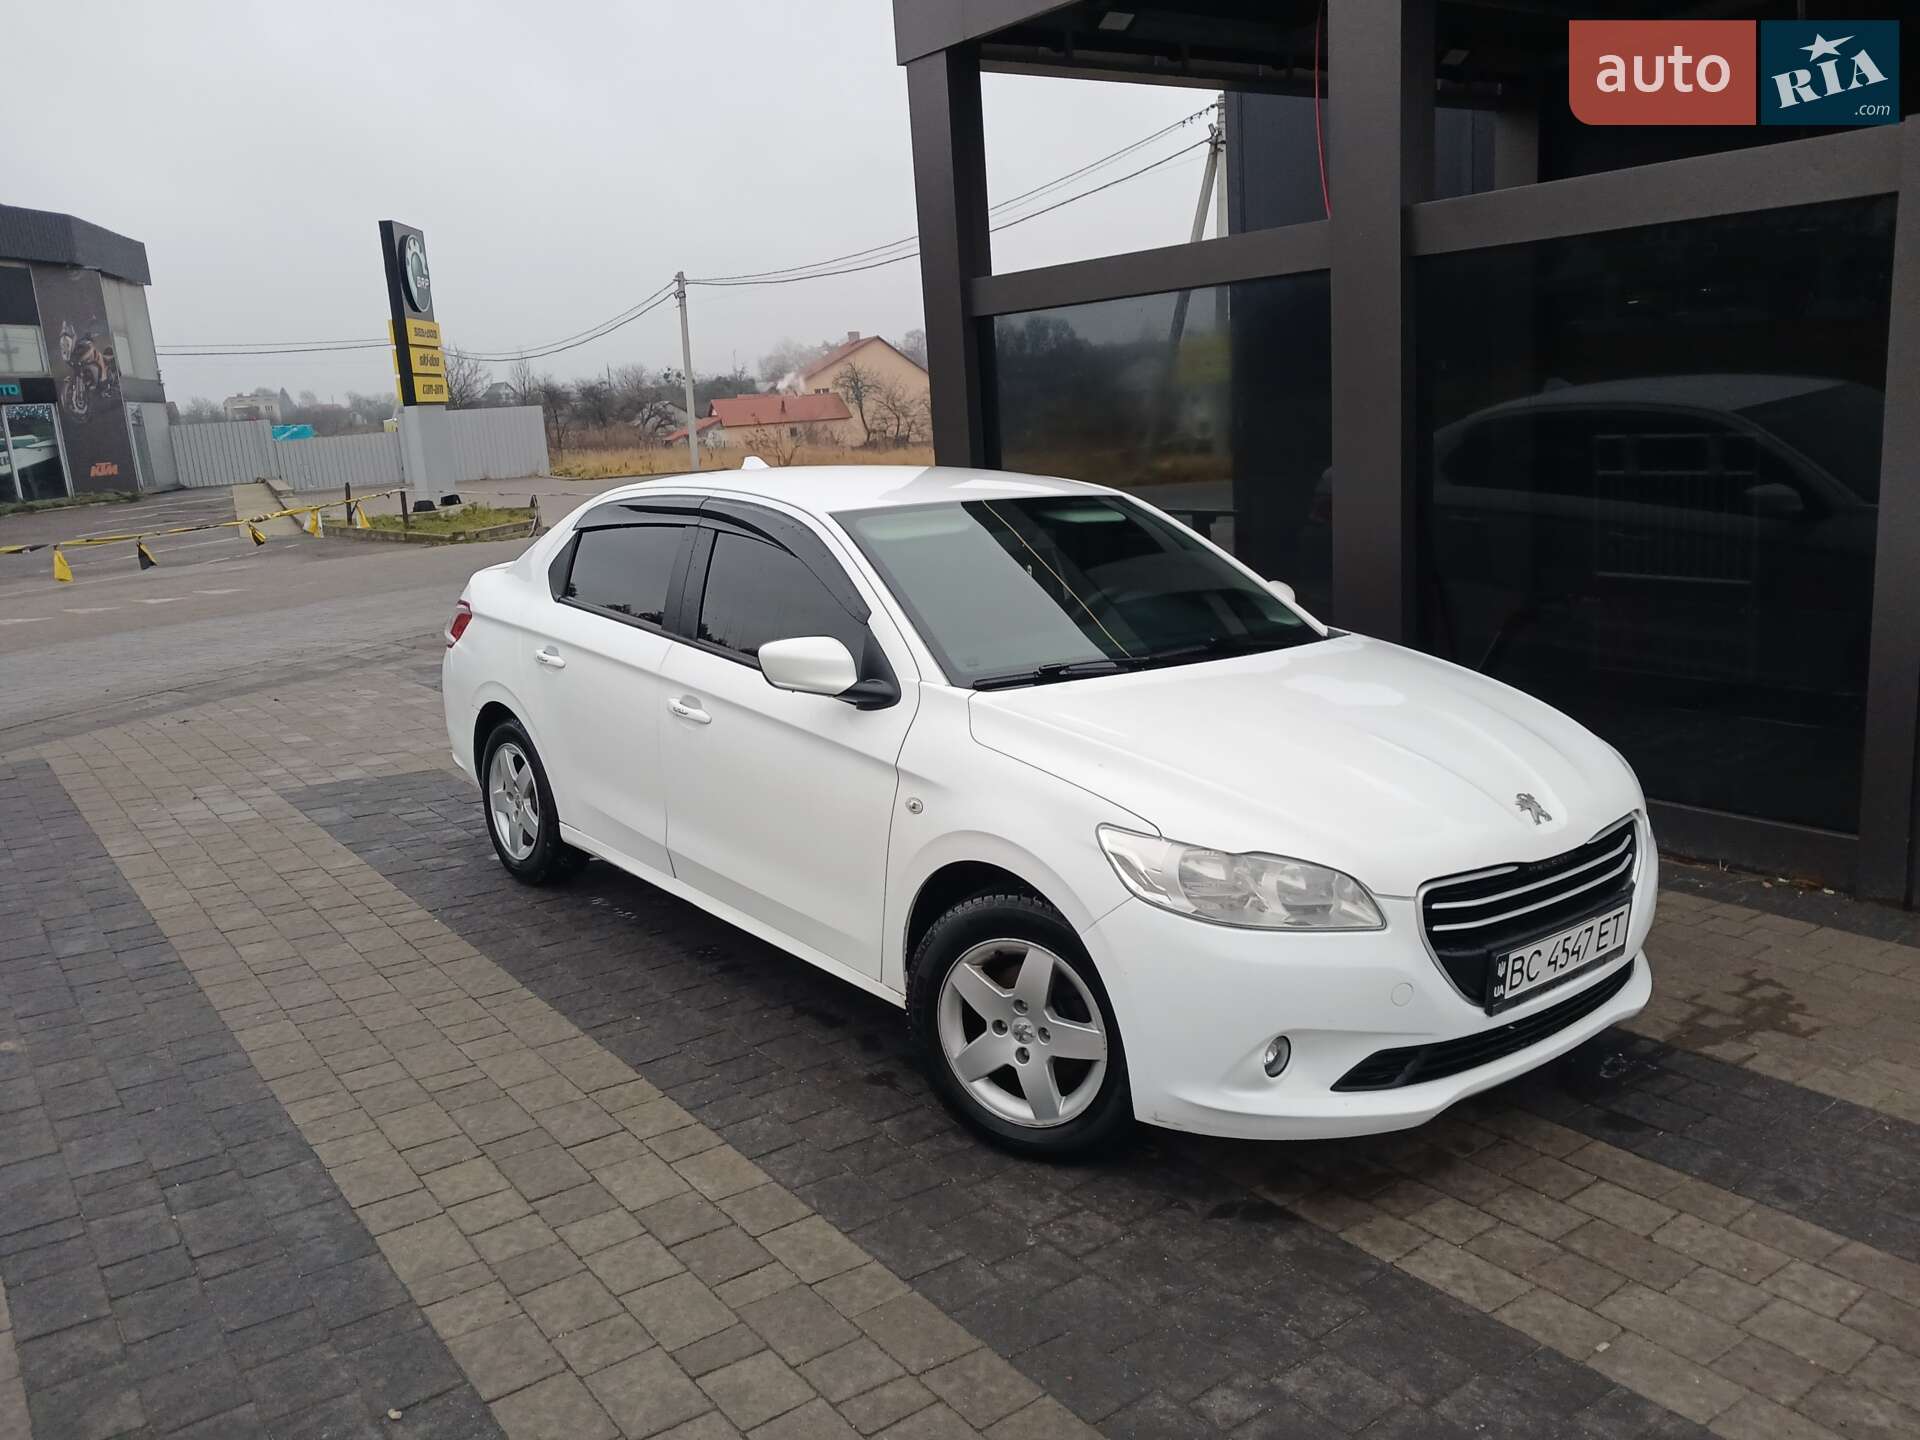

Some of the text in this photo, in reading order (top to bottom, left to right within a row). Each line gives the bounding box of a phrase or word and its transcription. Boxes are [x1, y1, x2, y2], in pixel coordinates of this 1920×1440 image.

[416, 276, 430, 289] BRP
[90, 462, 119, 477] KTM
[1508, 911, 1625, 991] BC 4547 ET
[1493, 983, 1504, 998] UA
